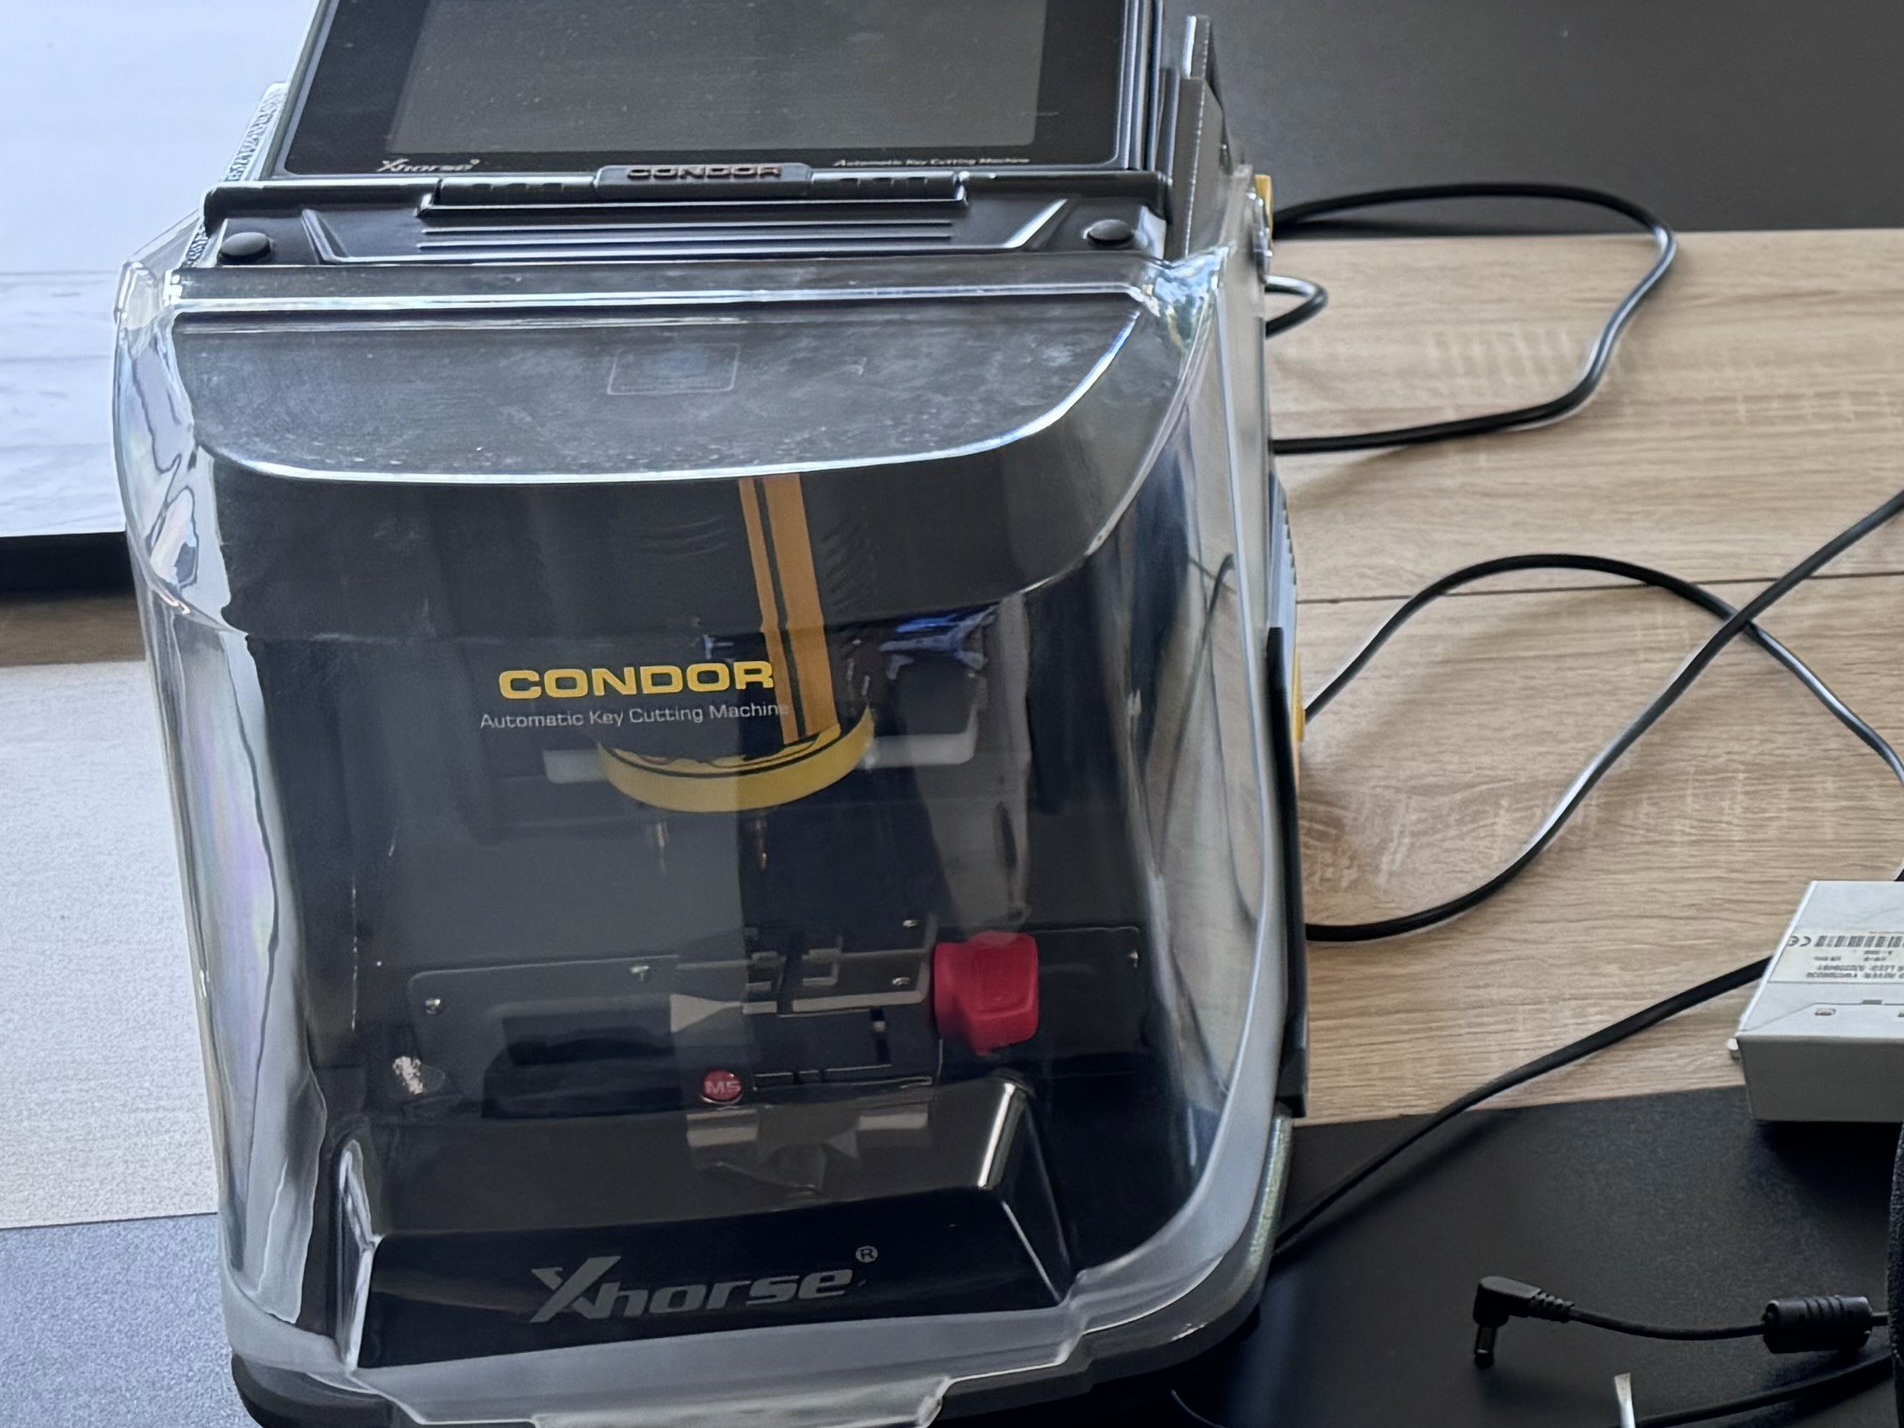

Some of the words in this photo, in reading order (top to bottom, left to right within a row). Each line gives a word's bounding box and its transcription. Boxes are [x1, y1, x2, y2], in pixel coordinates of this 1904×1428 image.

[627, 164, 782, 180] CONDOR
[498, 660, 775, 700] CONDOR
[480, 713, 585, 729] Automatic
[589, 710, 625, 727] Key
[629, 706, 704, 724] Cutting
[709, 701, 790, 719] Machine
[529, 1255, 853, 1323] Xhorse
